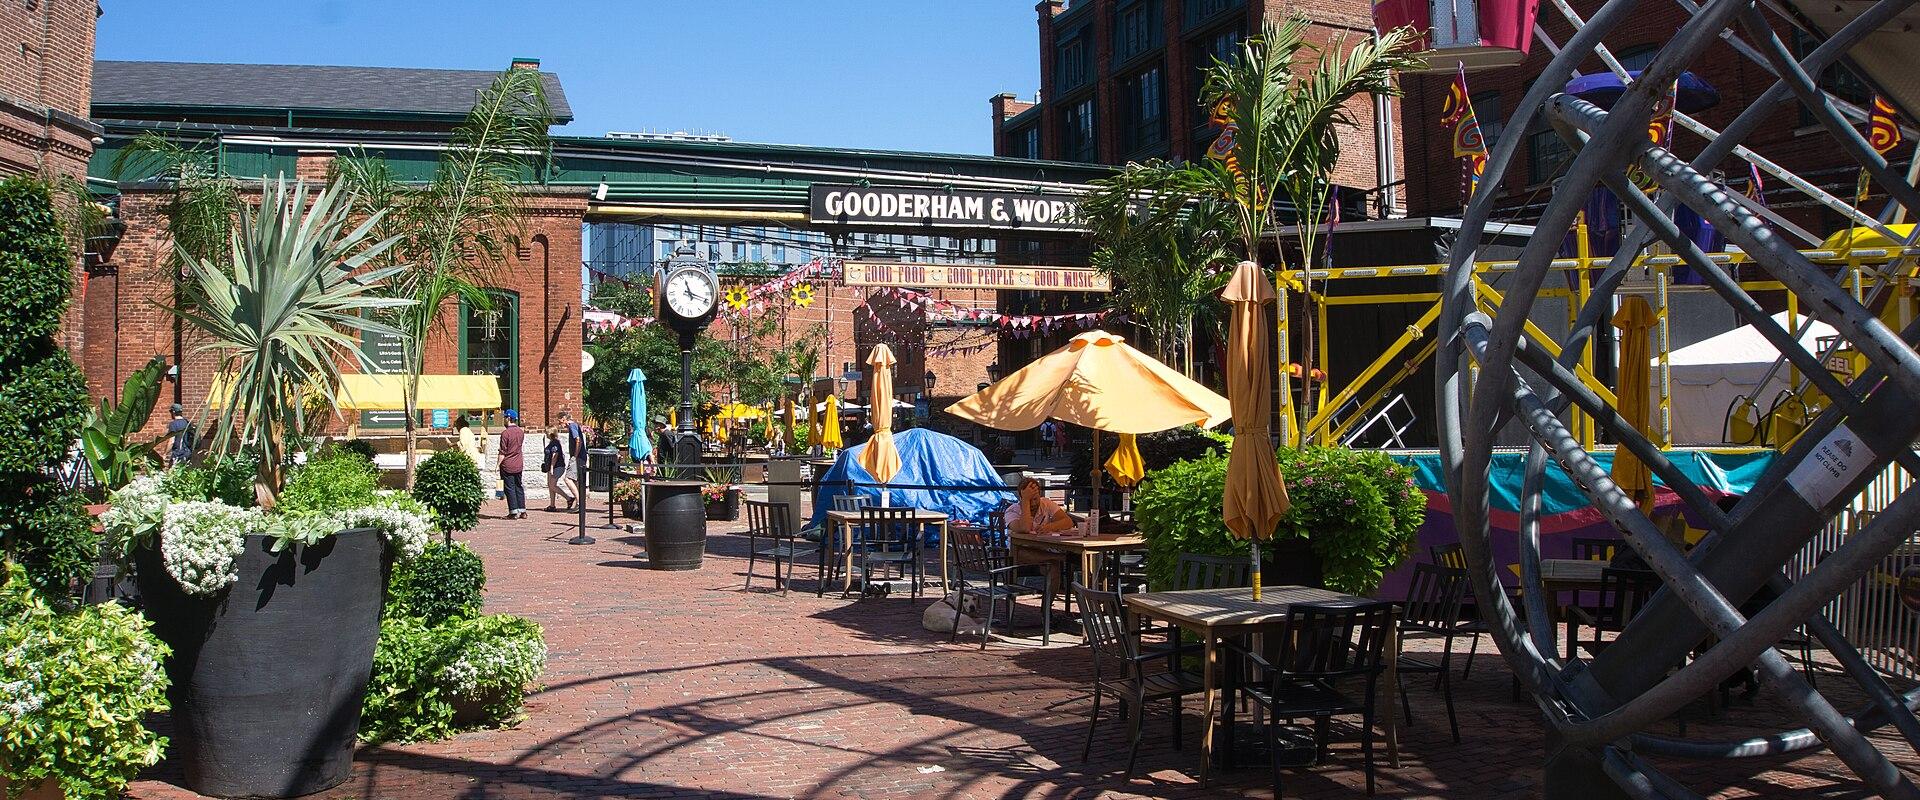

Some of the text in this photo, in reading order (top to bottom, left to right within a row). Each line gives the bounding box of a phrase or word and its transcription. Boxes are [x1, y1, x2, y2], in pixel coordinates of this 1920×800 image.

[825, 191, 983, 220] GOODERHAM
[990, 198, 1010, 221] &
[865, 266, 1092, 287] GOOD FOOD GOOD PEOPLE GOOD MUSIC
[1826, 357, 1853, 374] EEL
[1815, 452, 1840, 478] NOT CLIMB
[1821, 446, 1847, 471] PLEASE DO
